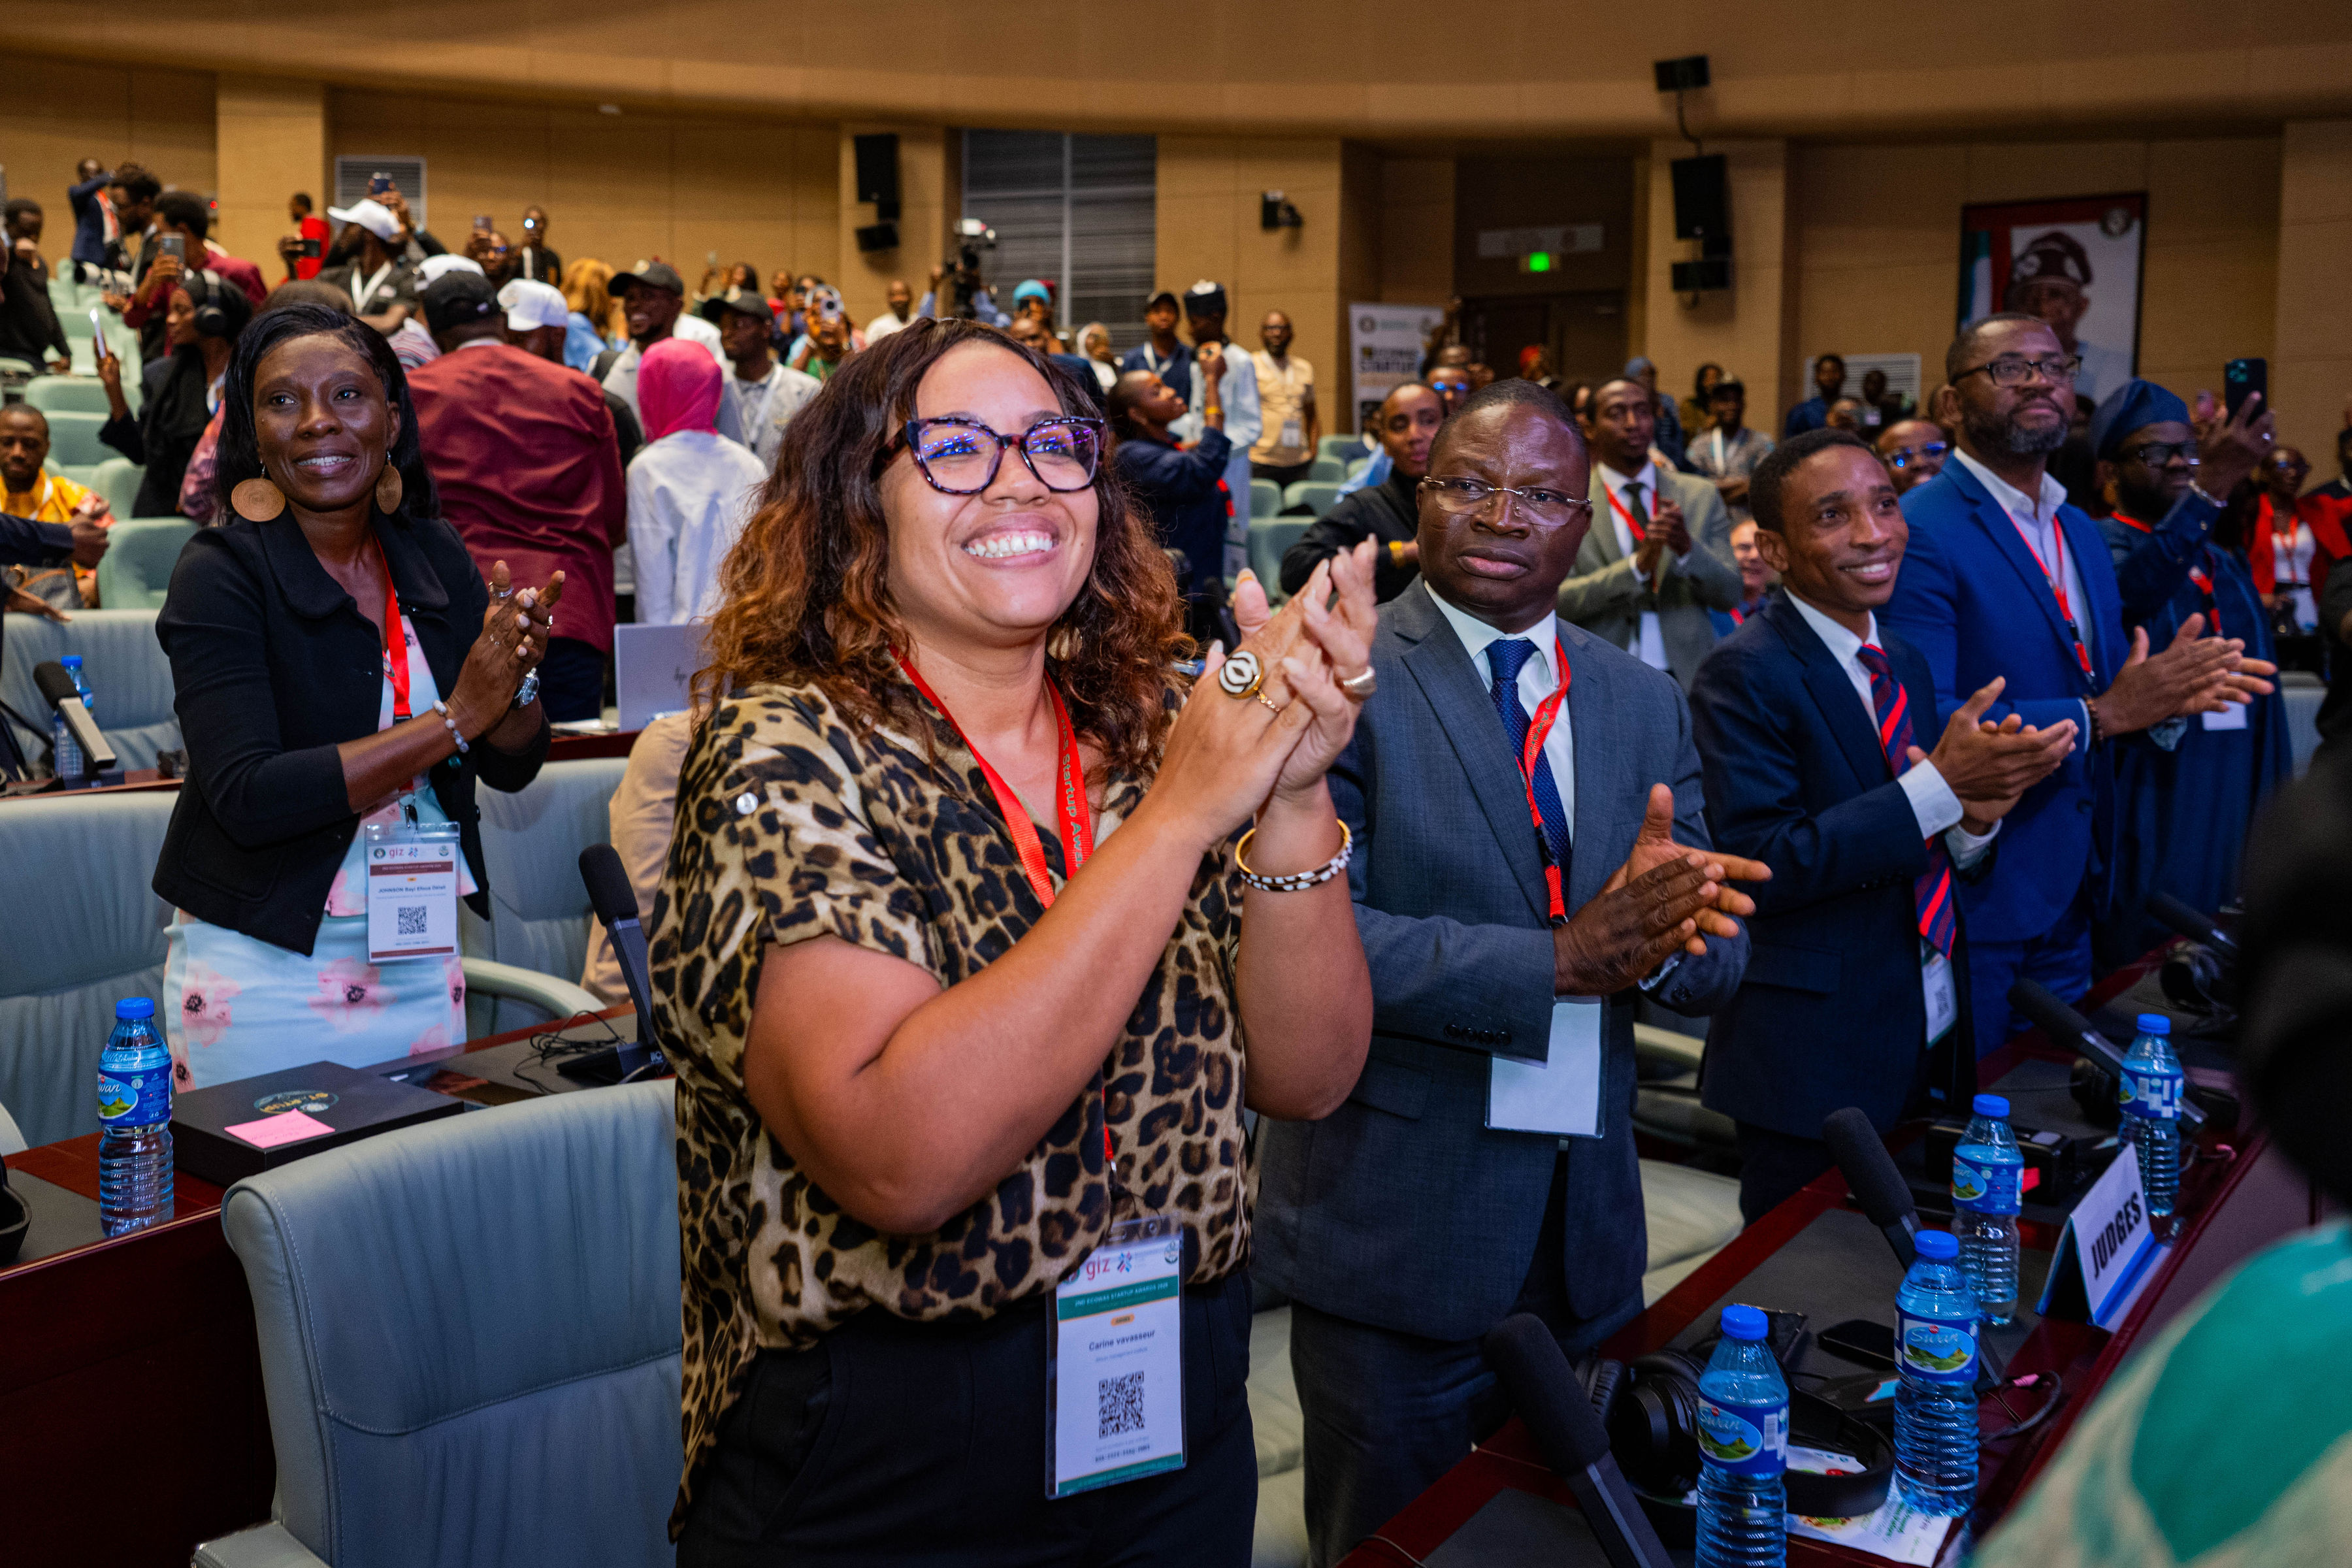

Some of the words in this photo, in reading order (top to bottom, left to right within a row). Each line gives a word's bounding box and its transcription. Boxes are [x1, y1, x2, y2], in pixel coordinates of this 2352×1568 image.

[1062, 753, 1077, 817] Startup
[389, 848, 404, 858] giz
[2091, 1191, 2142, 1280] JUDGES
[1086, 1255, 1110, 1281] giz
[1111, 1290, 1134, 1299] STARTUP
[1089, 1338, 1114, 1352] Carine
[1117, 1329, 1156, 1346] vavasseur
